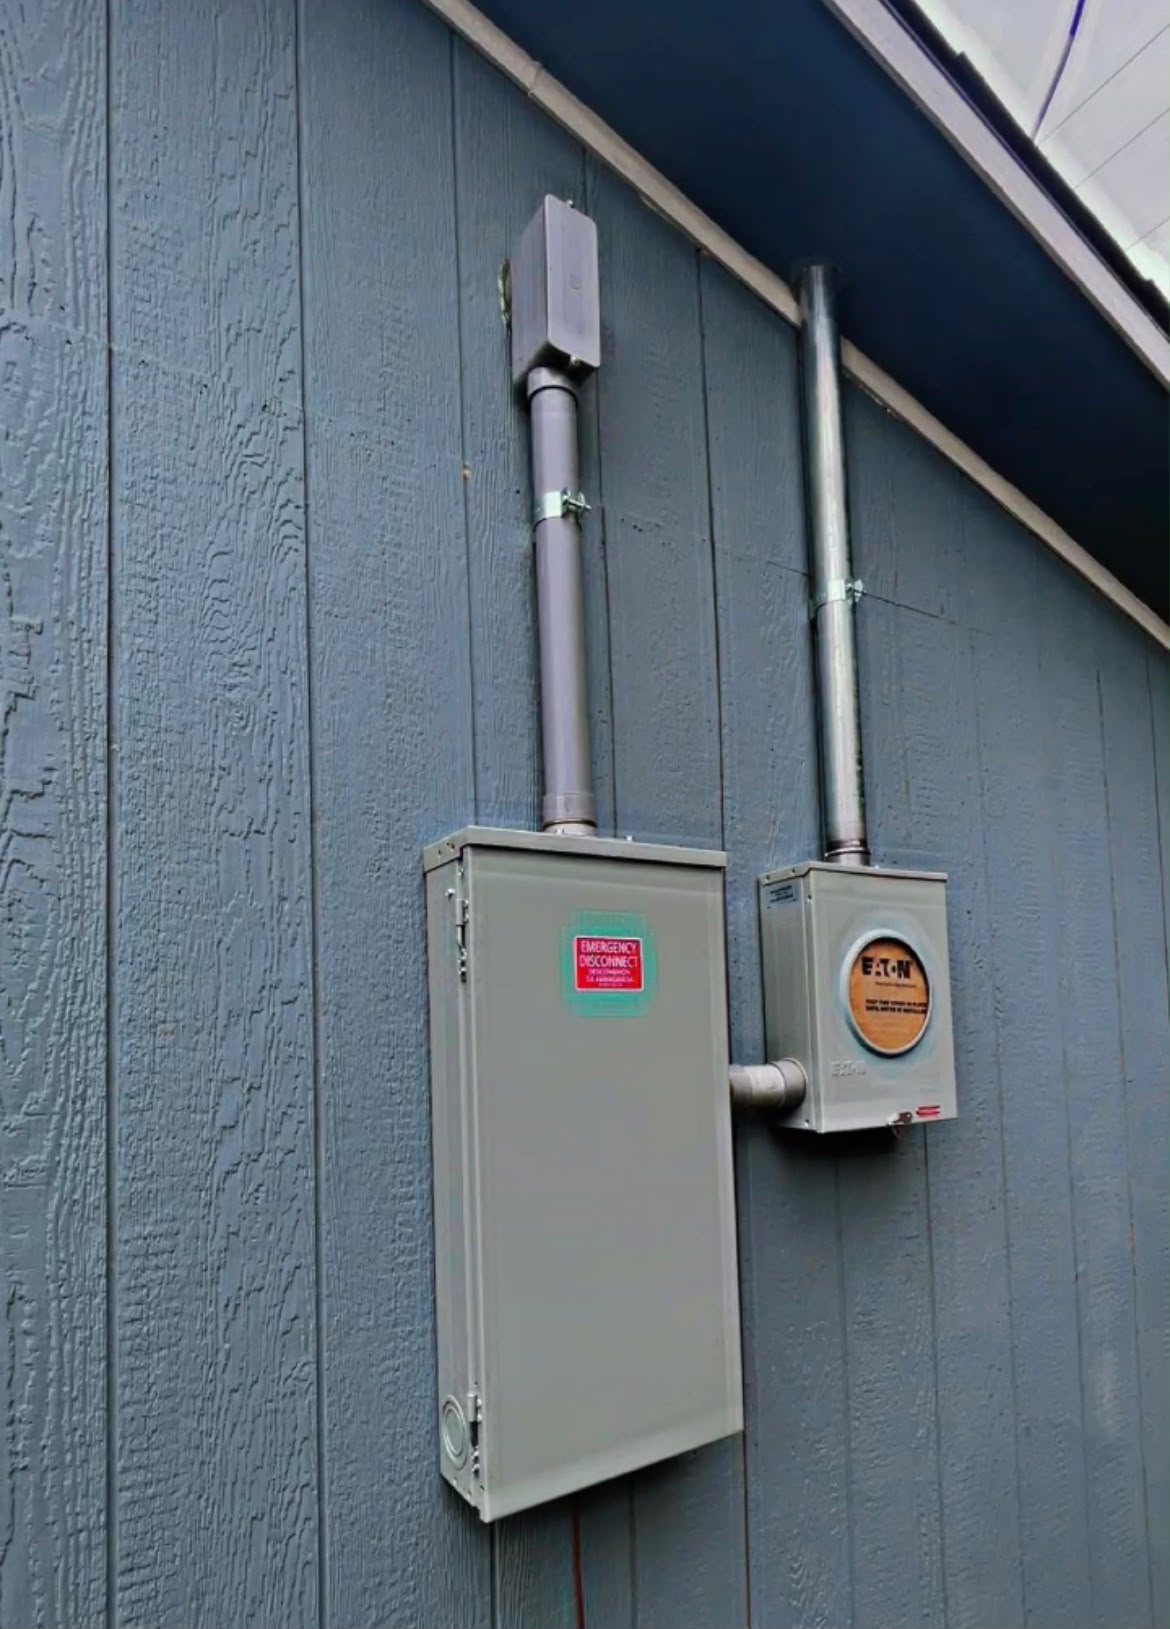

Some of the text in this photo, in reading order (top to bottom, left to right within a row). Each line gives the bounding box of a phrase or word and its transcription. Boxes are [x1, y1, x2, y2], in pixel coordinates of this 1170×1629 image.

[581, 940, 637, 954] EMERGENCY
[580, 954, 639, 968] DISCONNECT
[861, 957, 912, 979] EATON
